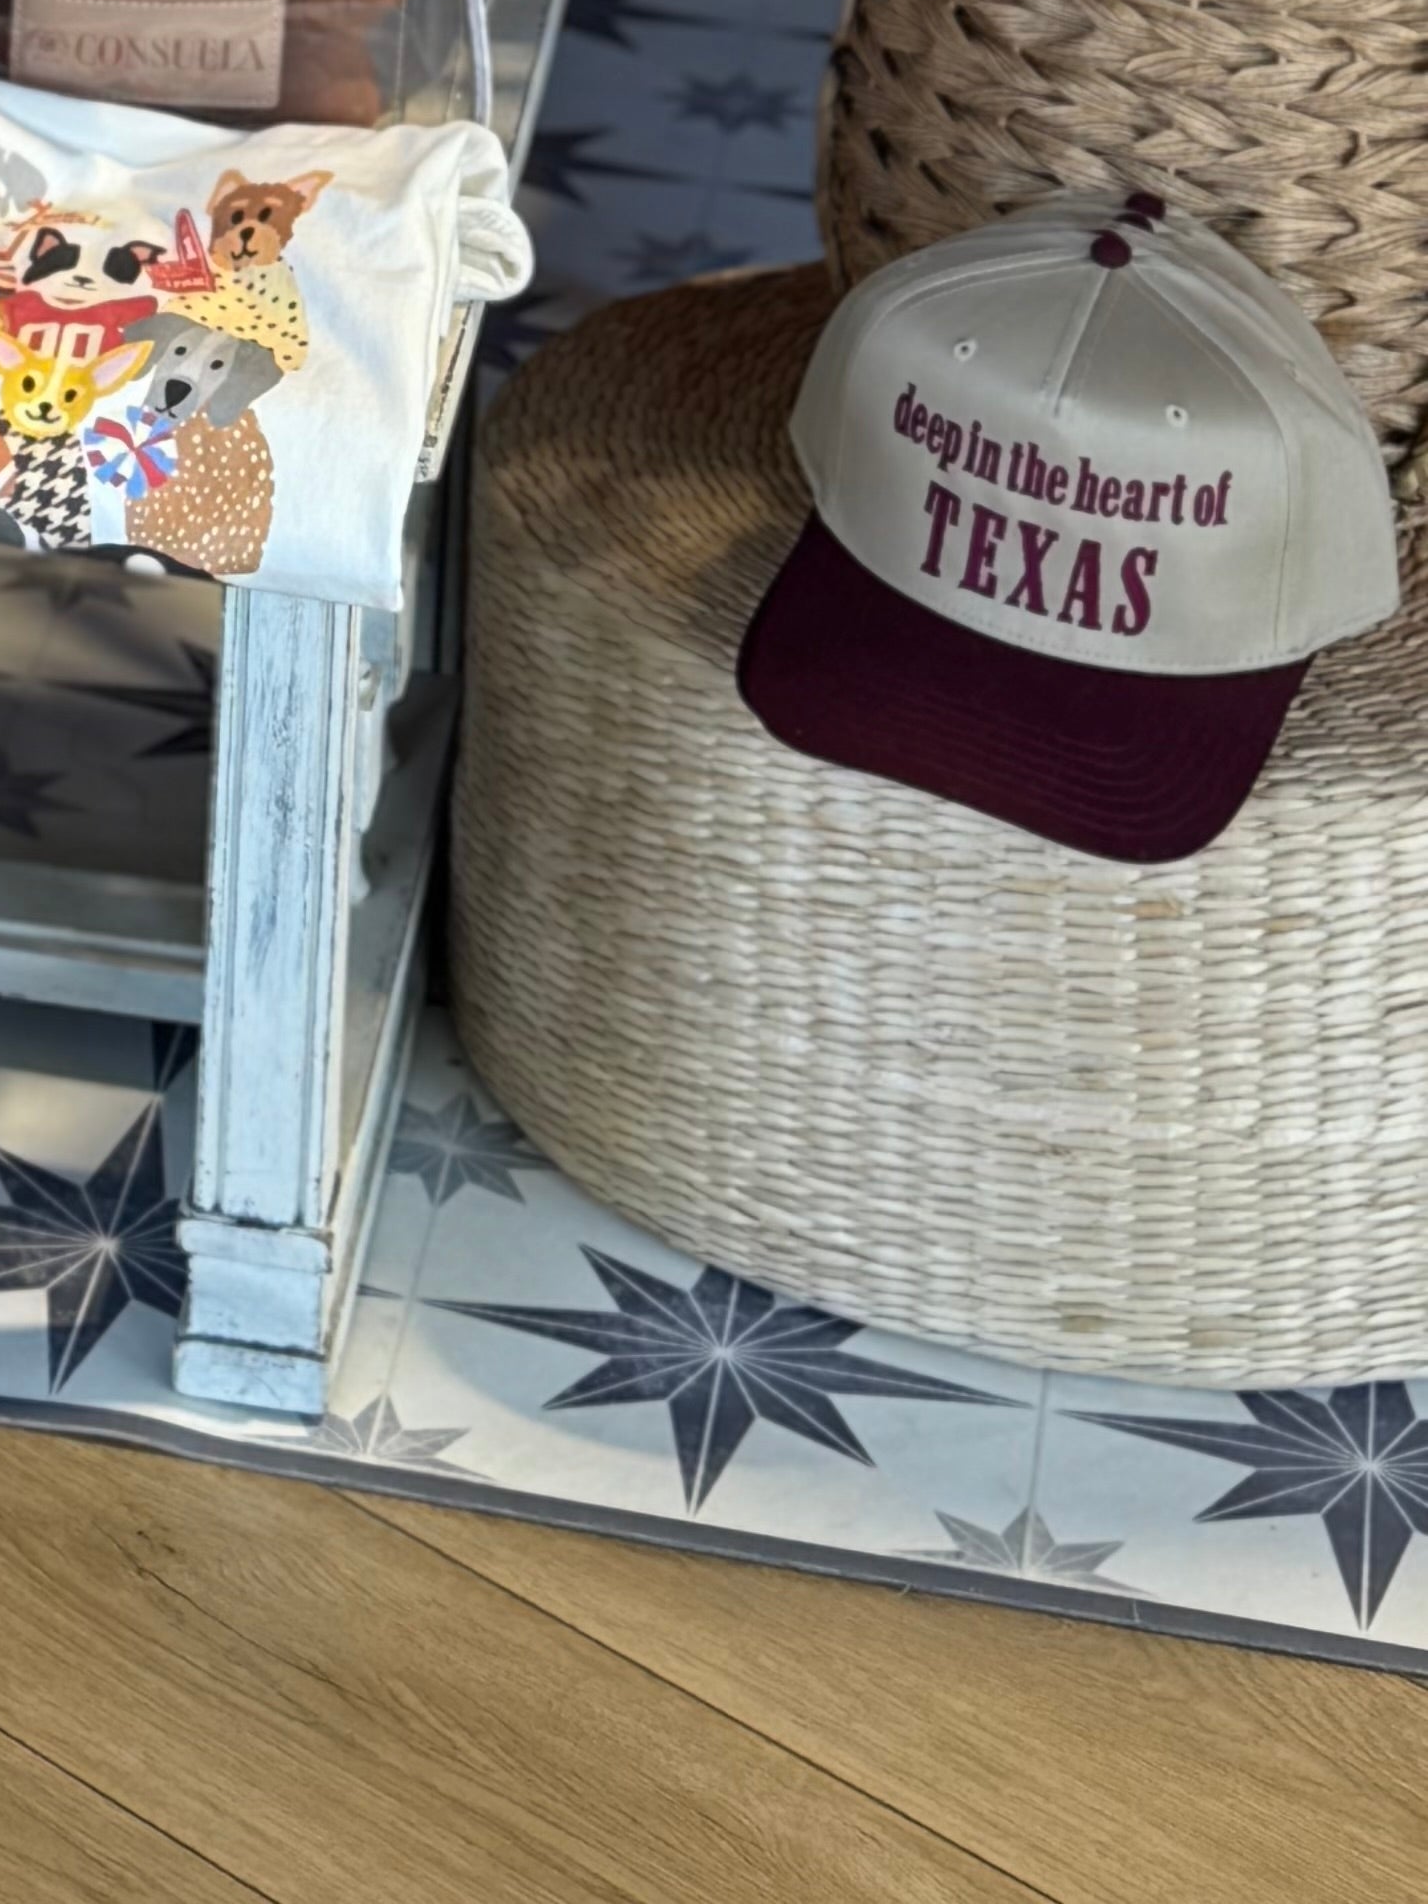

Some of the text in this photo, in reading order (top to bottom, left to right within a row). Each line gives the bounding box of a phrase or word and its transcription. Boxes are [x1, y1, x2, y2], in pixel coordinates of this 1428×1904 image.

[75, 33, 266, 72] CONSUELA
[893, 382, 1233, 527] deep in the heart of
[920, 480, 1159, 637] TEXAS
